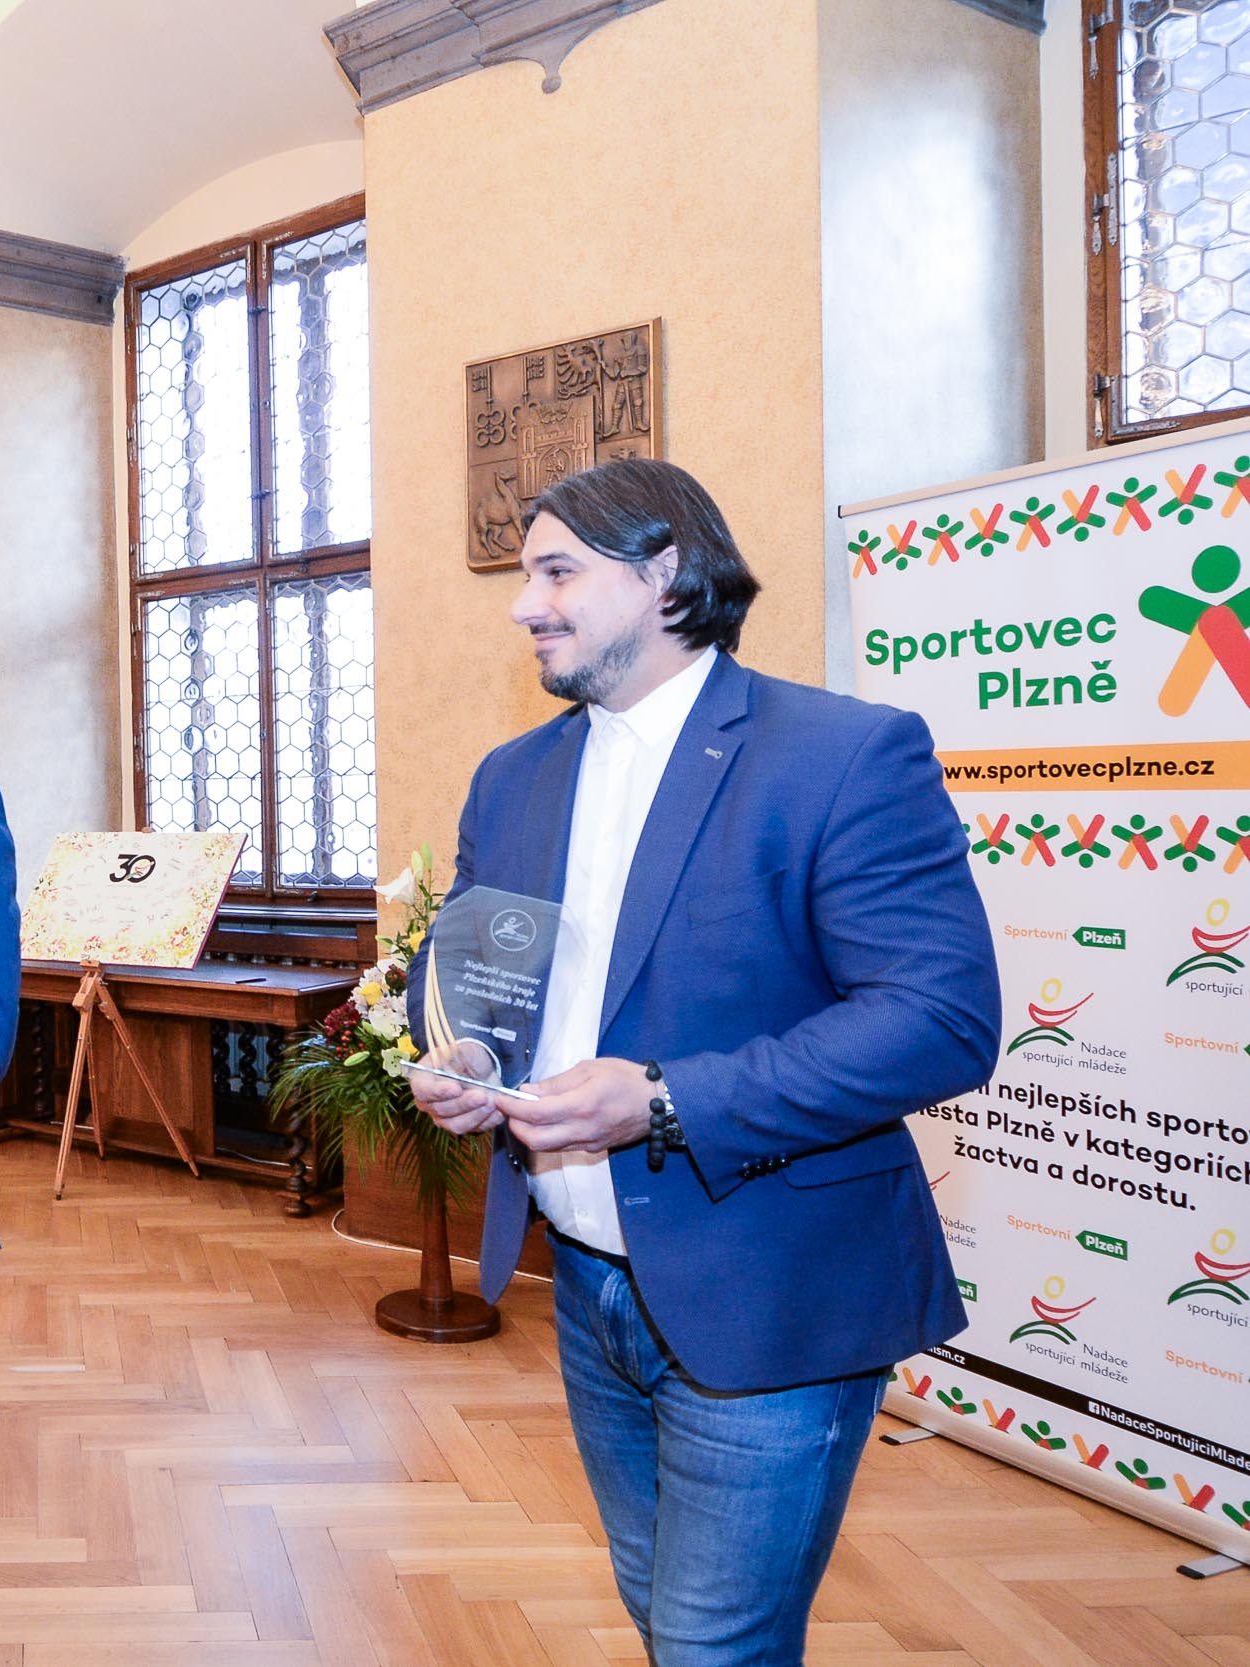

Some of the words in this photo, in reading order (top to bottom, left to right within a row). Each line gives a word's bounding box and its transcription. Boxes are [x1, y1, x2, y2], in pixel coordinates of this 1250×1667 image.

[865, 613, 1117, 675] Sportovec
[978, 659, 1117, 710] Plzně
[943, 756, 1215, 785] ww.sportovecplzne.cz
[109, 853, 157, 883] 30
[1004, 925, 1068, 941] Sportovní
[1082, 930, 1122, 945] Plzeň
[1185, 980, 1243, 998] sportující
[1080, 1041, 1126, 1059] Nadace
[1165, 1032, 1239, 1054] Sportovní
[1022, 1051, 1073, 1068] sportující
[1078, 1059, 1126, 1075] mládeže
[998, 1083, 1136, 1124] nejlepších
[1146, 1111, 1250, 1145] sporto
[987, 1110, 1055, 1143] Plzně
[1063, 1131, 1080, 1148] v
[954, 1135, 1039, 1175] žactva
[1047, 1163, 1063, 1180] a
[1072, 1164, 1196, 1211] dorostu.
[944, 1231, 977, 1249] ládeže
[1007, 1215, 1071, 1241] Sportovní
[1085, 1234, 1124, 1256] Plzeň
[1083, 1343, 1128, 1369] Nadace
[1165, 1350, 1244, 1384] Sportovní
[1080, 1361, 1128, 1384] mládeže
